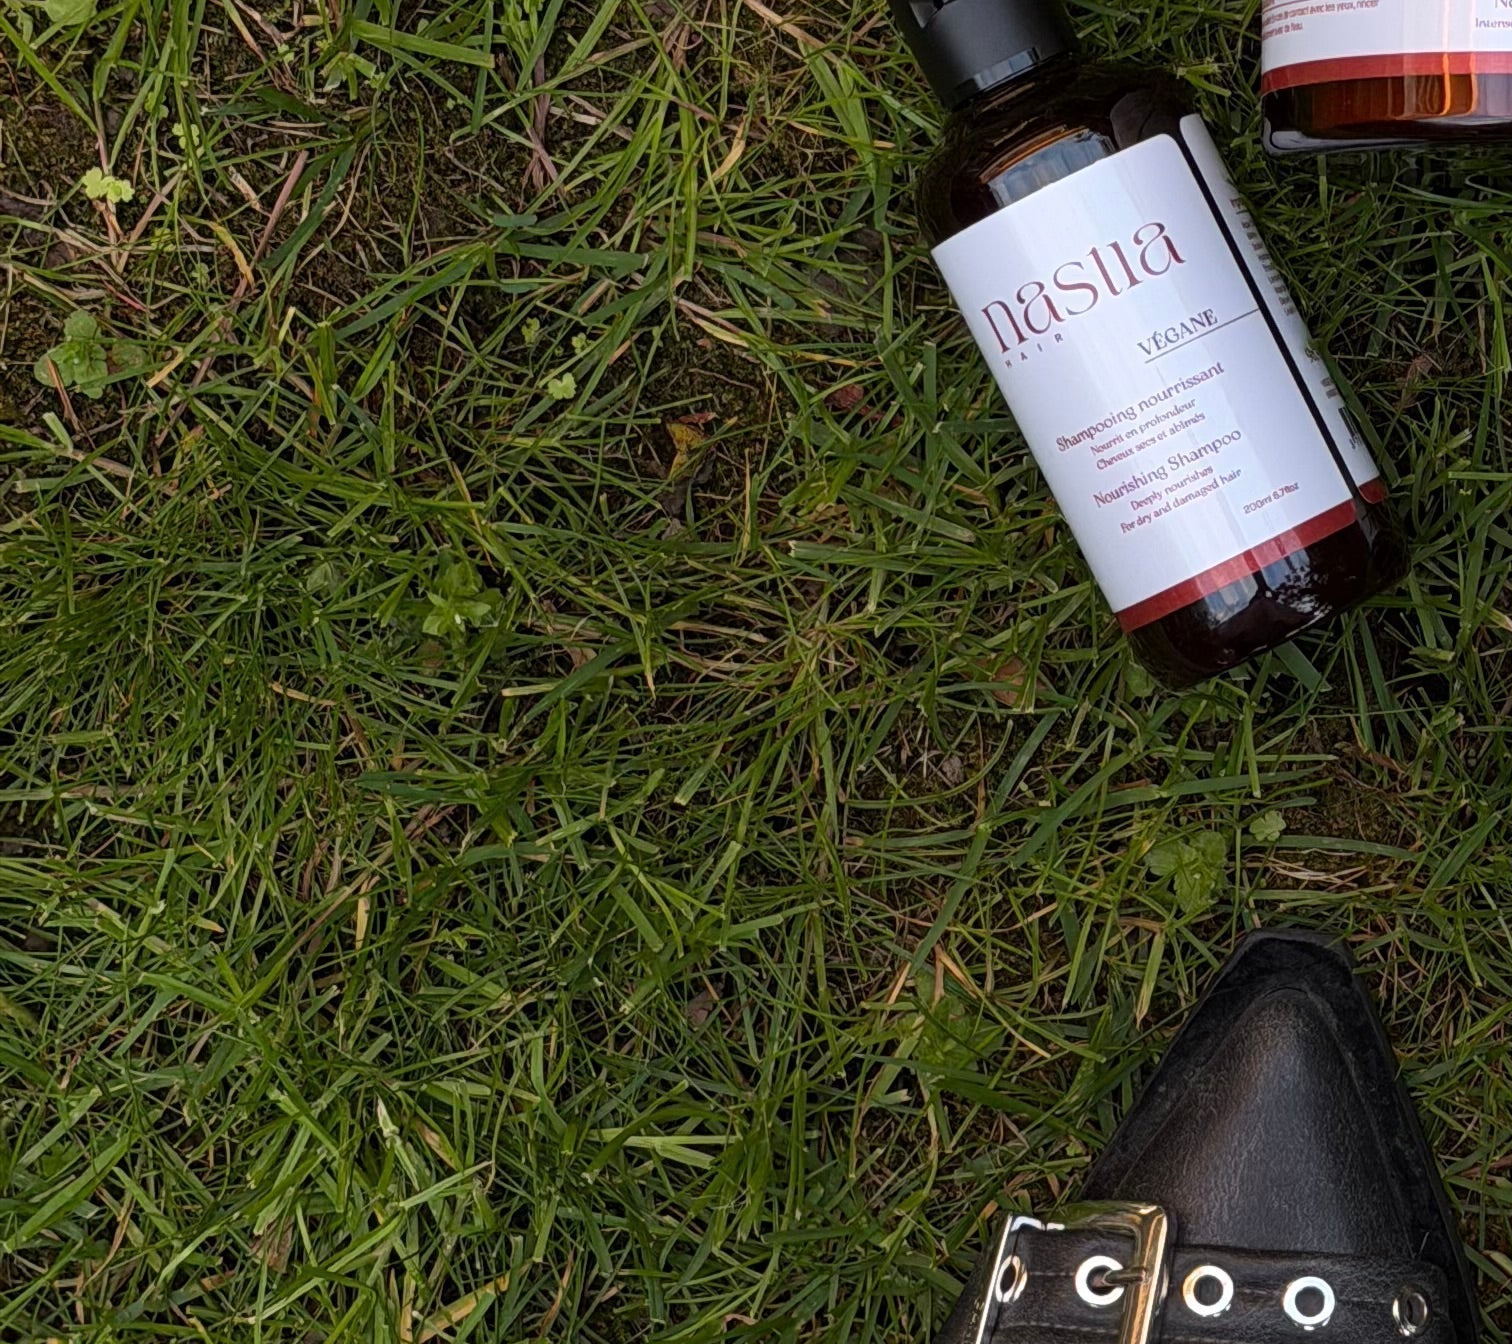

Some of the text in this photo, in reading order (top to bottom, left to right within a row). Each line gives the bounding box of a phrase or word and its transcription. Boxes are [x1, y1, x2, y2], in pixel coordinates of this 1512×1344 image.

[1137, 308, 1218, 356] VÉGANE
[1055, 361, 1225, 452] Shampooing nourrissant
[1125, 427, 1138, 440] en
[1139, 398, 1197, 434] profondeur
[1093, 430, 1242, 508] Nourishing Shampoo
[1096, 447, 1135, 470] Cheveux
[1135, 436, 1156, 452] secs
[1157, 431, 1168, 442] et
[1120, 468, 1242, 534] For dry and damaged hair
[1130, 465, 1214, 511] Deeply nourishes
